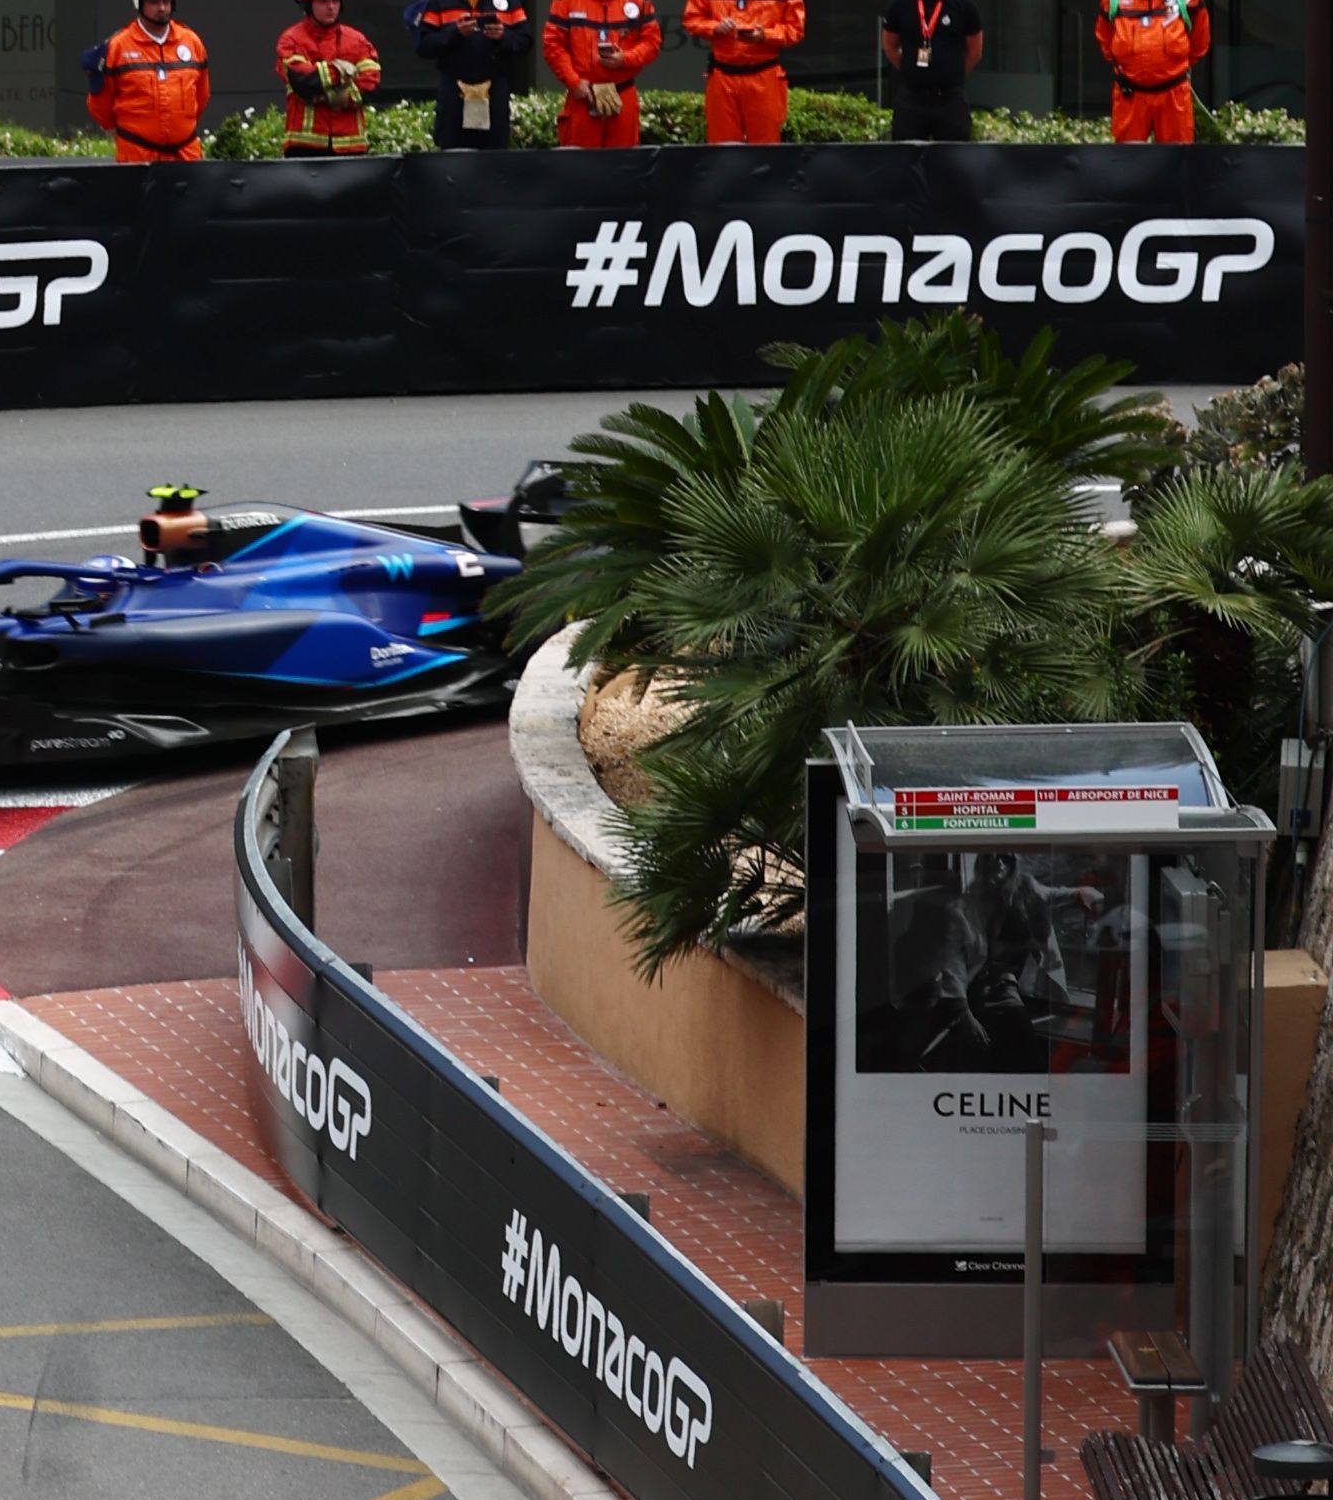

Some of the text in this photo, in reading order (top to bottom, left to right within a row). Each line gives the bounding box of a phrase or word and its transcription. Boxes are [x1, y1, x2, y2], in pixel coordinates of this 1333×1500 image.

[566, 218, 1275, 307] #MonacoGP
[937, 791, 1014, 801] SAINT-ROMAN
[1038, 789, 1169, 801] 110 AEROPORT DE NICE
[953, 804, 999, 815] HOPITAL
[943, 818, 1009, 828] FONTVIEILLE
[933, 1092, 1052, 1117] CELINE
[959, 1126, 1027, 1135] PLACE DU CASIN
[968, 1261, 1025, 1270] Clear Channe
[501, 1208, 713, 1470] #MonacoGP
